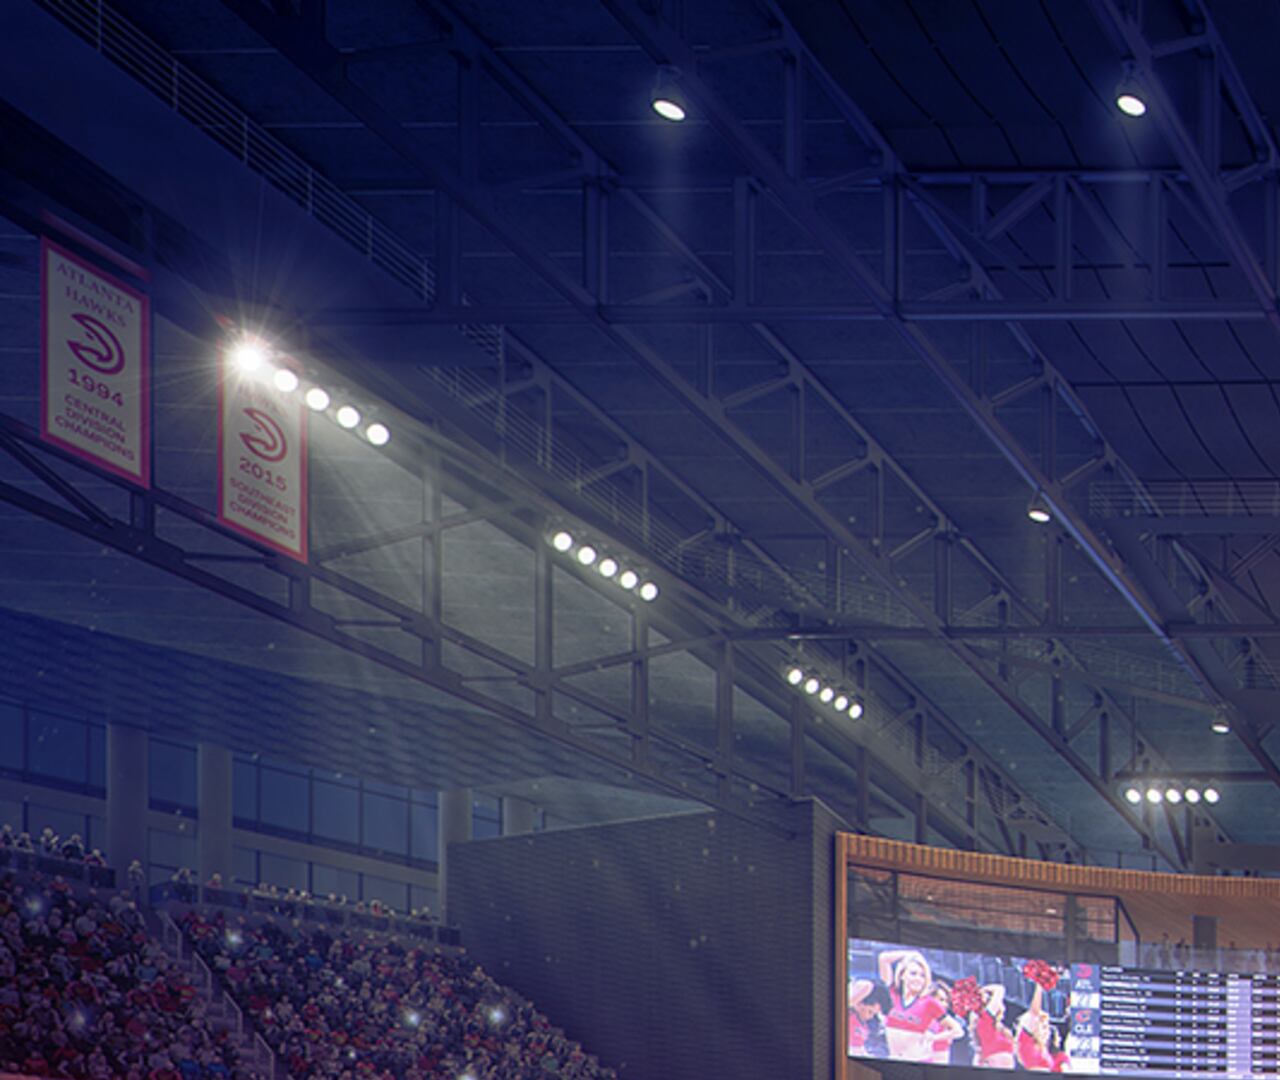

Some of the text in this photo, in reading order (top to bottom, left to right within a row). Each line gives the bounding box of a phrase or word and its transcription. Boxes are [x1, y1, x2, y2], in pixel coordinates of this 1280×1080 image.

[56, 262, 135, 314] ATLANTA
[66, 285, 126, 328] HAWKS
[68, 367, 124, 407] 1994
[64, 393, 126, 433] CENTRAL
[64, 406, 126, 443] DIVISION
[54, 415, 135, 461] CHAMPIONS
[239, 455, 288, 492] 2015
[229, 476, 296, 517] SOUTHEAST
[237, 492, 289, 525] DIVISION
[228, 500, 296, 540] CHAMPIONS
